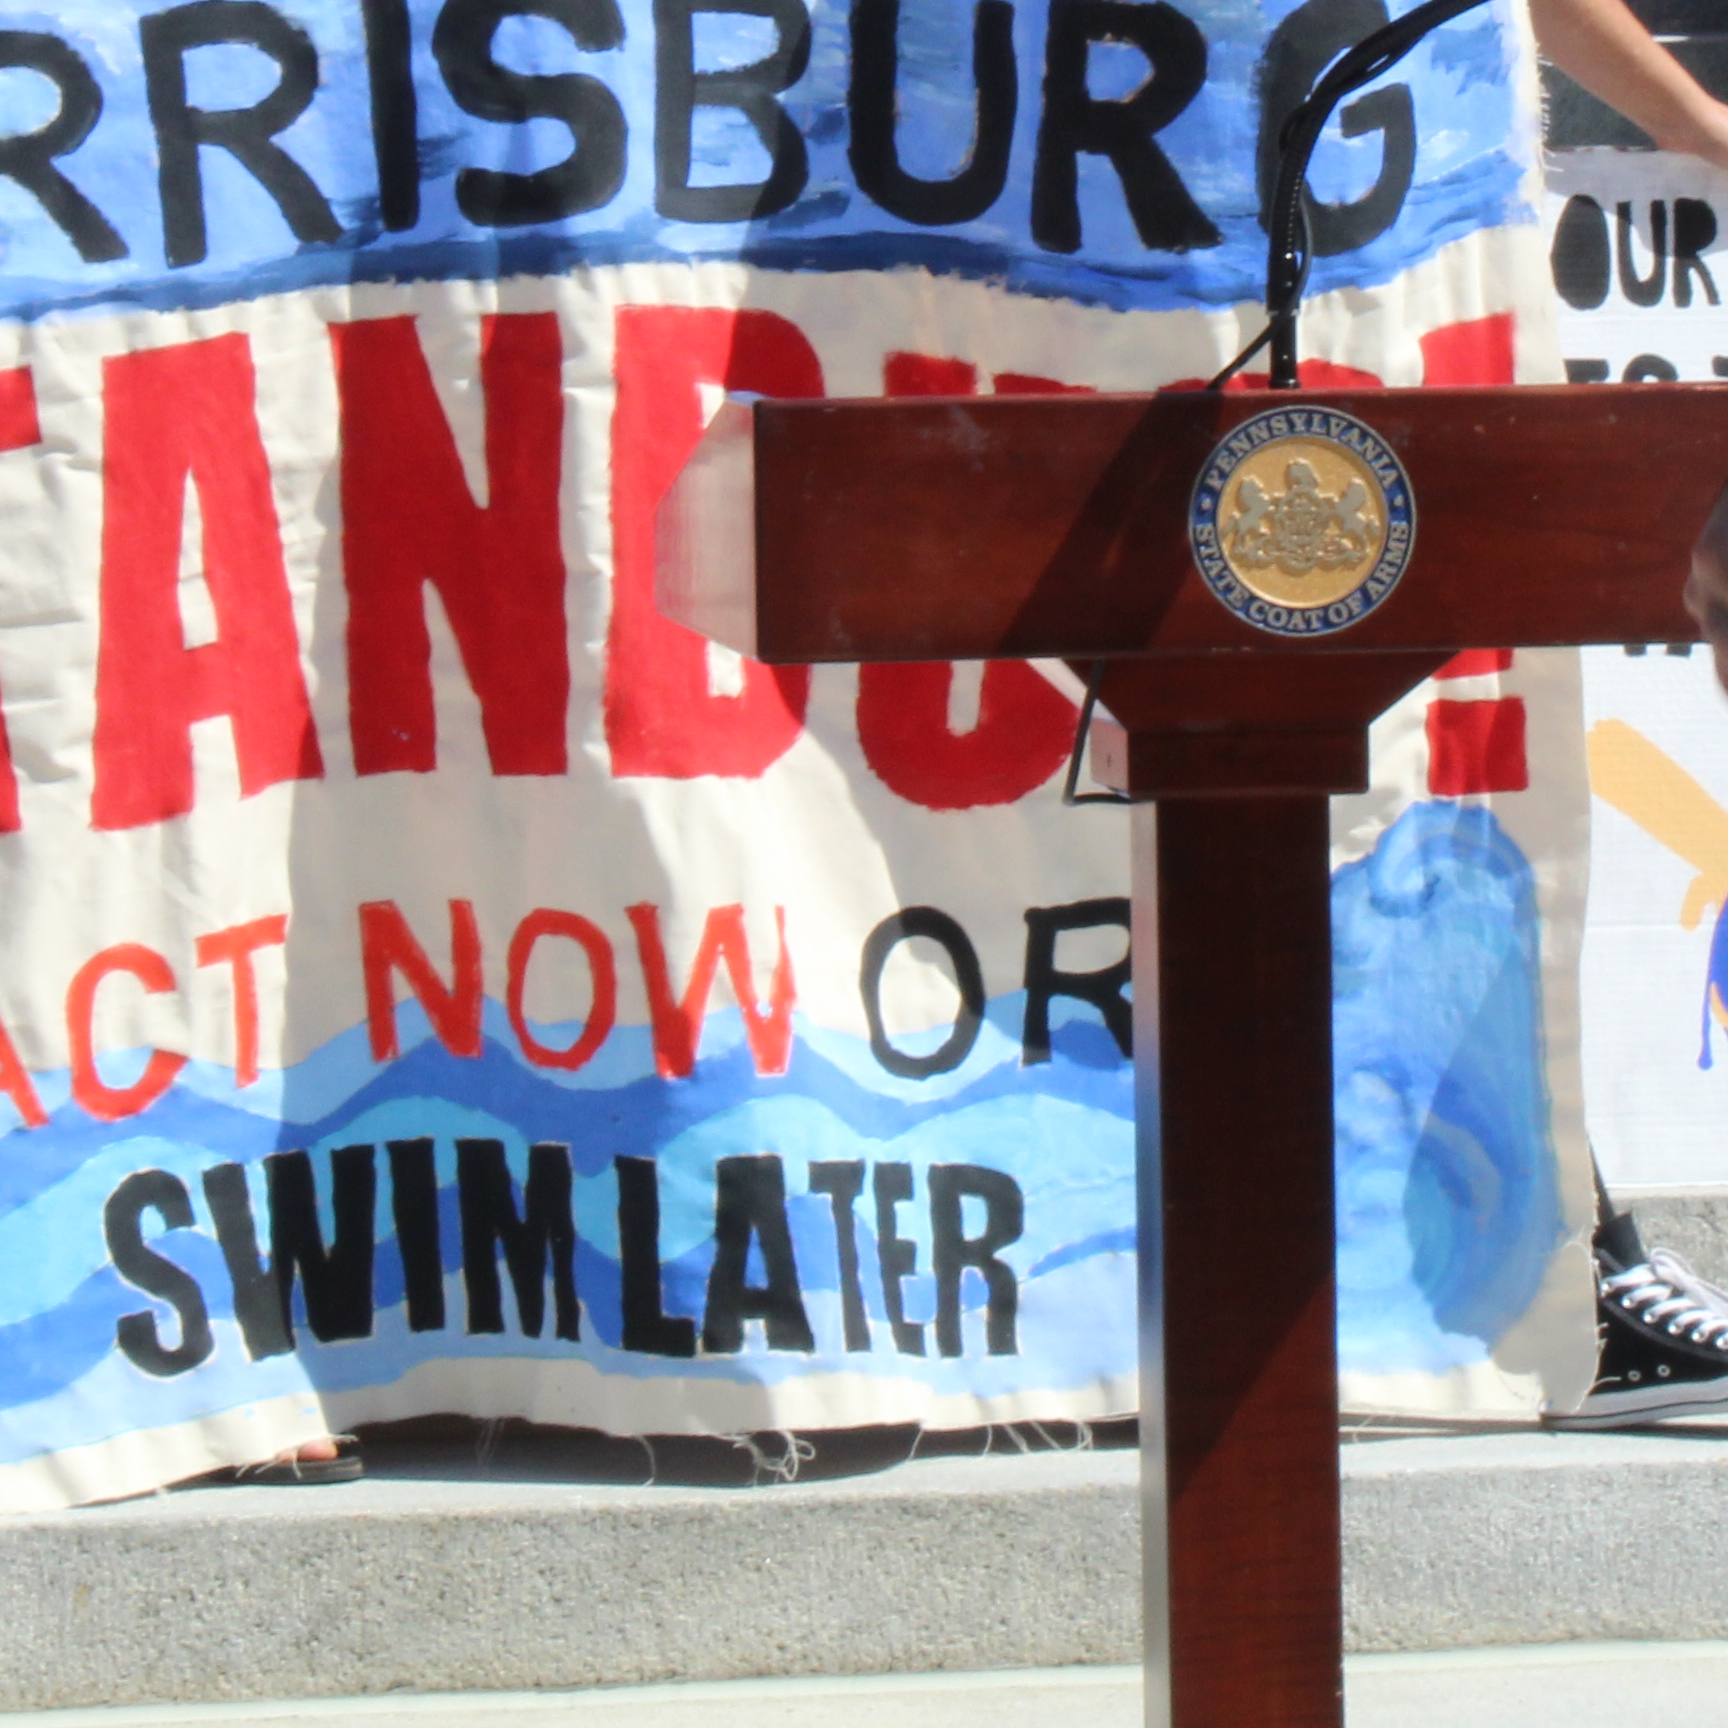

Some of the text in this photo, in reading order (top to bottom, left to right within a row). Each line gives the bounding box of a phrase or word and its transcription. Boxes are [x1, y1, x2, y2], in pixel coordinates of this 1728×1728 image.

[1550, 194, 1720, 311] OUR
[1204, 412, 1401, 491] PENNSYLVANIA
[1195, 522, 1409, 631] STATE COAT OF ARMS
[357, 897, 796, 1086] NOW
[858, 896, 1135, 1080] OR
[106, 1138, 1026, 1378] SWIM LATER
